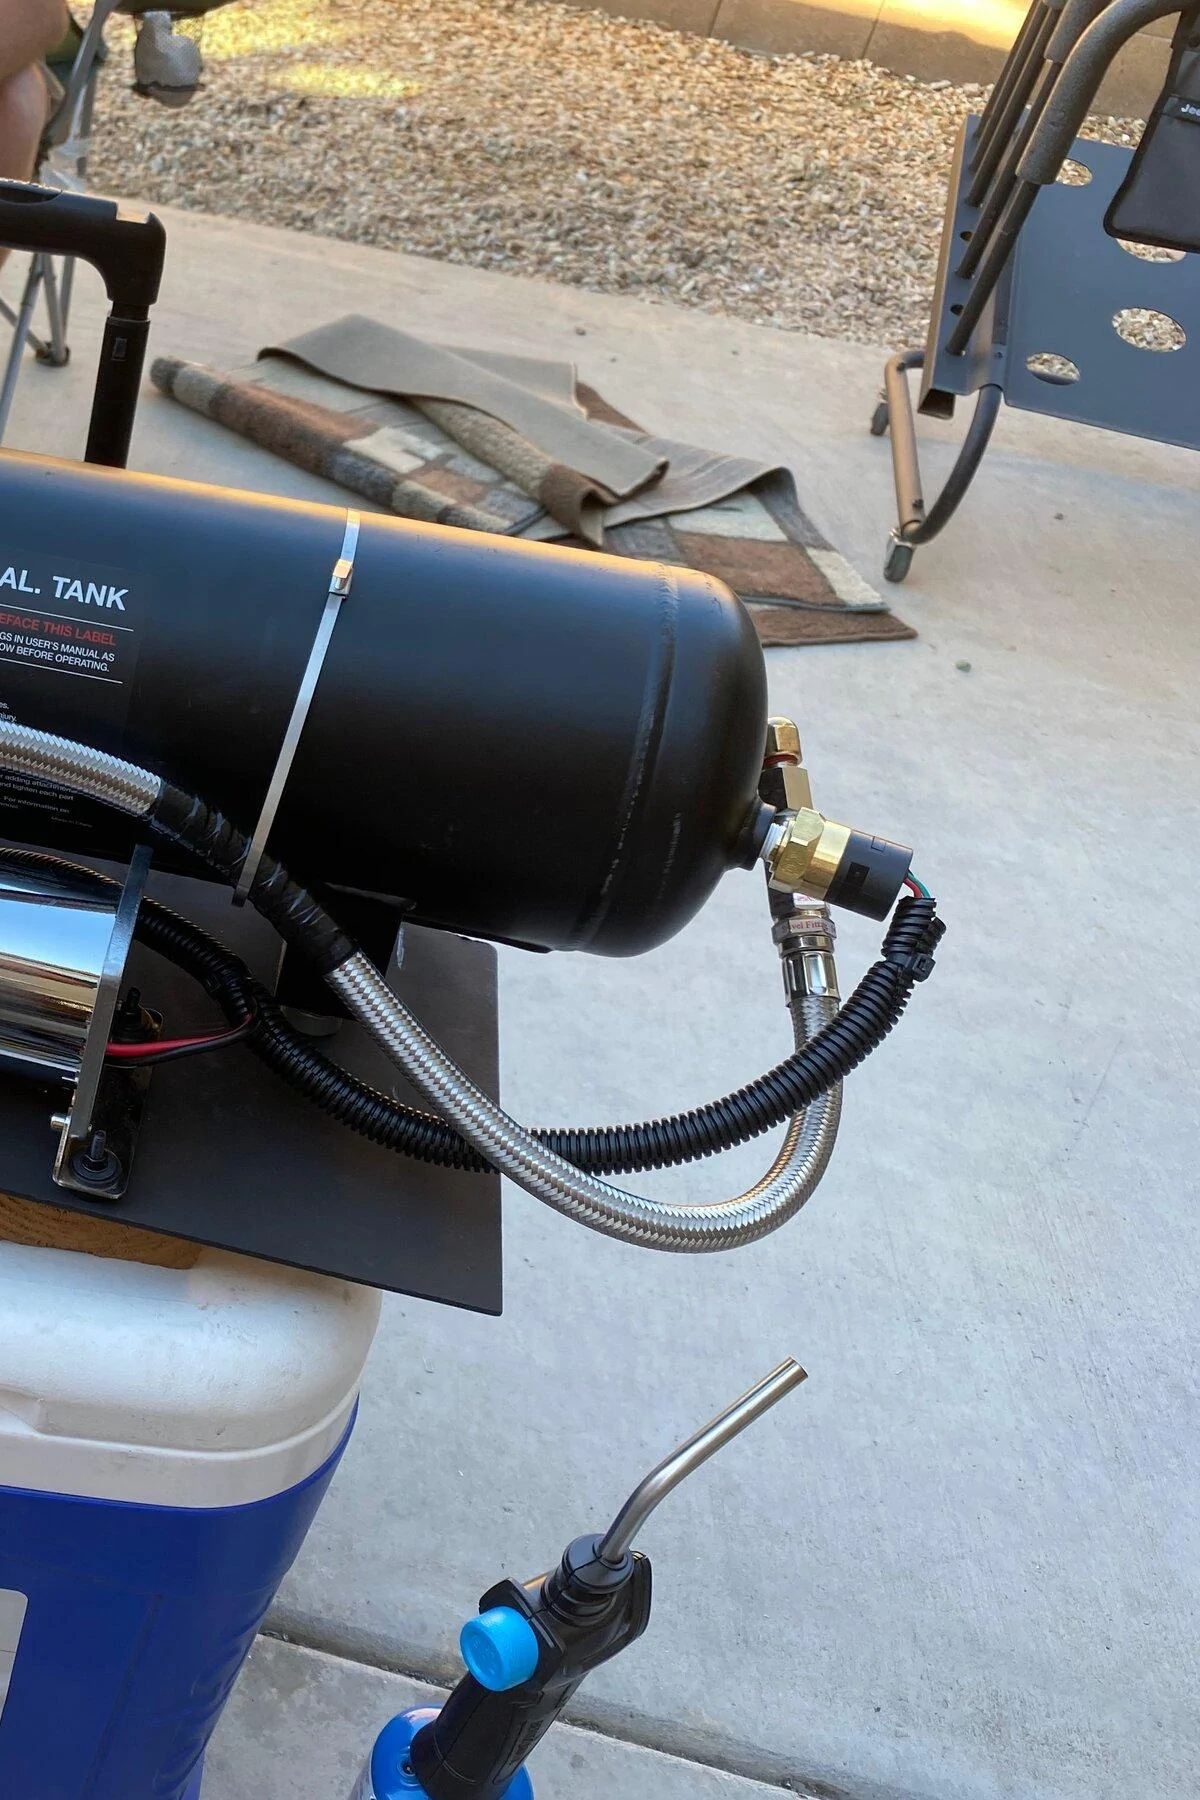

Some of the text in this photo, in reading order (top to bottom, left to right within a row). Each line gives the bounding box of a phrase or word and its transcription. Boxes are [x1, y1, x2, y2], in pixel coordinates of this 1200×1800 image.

[52, 575, 129, 611] TANK
[43, 621, 73, 637] THIS
[75, 628, 117, 646] LABEL
[13, 634, 24, 643] IN
[25, 636, 59, 650] USER'S
[60, 643, 101, 659] MANUAL
[101, 652, 115, 661] AS
[15, 646, 53, 660] BEFORE
[54, 653, 110, 672] OPERATING.
